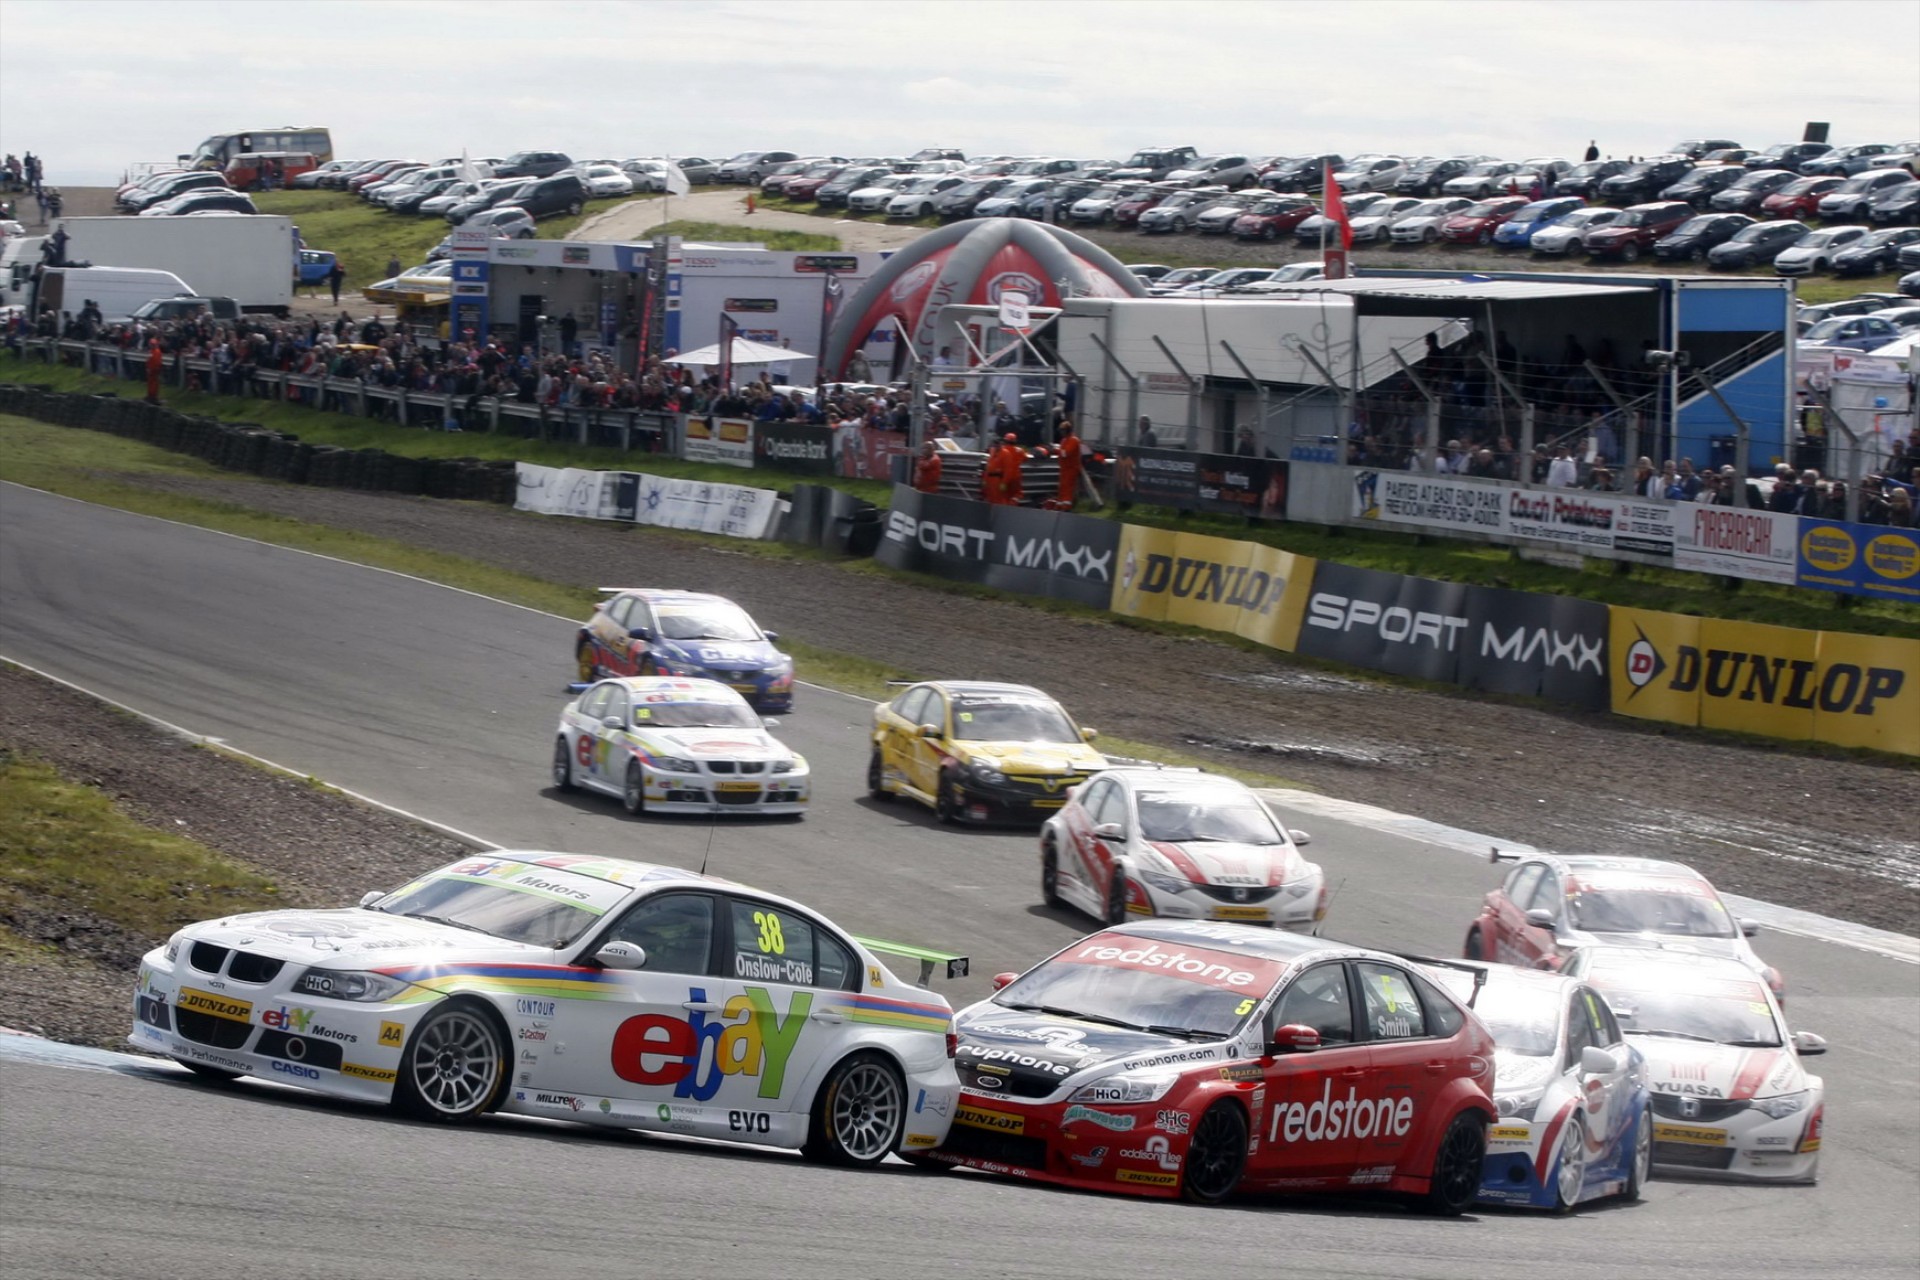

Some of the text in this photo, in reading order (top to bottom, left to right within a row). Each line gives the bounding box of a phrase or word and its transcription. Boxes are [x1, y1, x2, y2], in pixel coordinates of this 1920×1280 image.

[808, 440, 827, 459] Bank
[1386, 481, 1502, 510] PARTIES AT EAST END PARK
[1510, 492, 1549, 522] Couch
[1552, 496, 1613, 530] Potatoes
[1521, 523, 1537, 536] Home
[1695, 509, 1772, 557] FIREBREAK
[886, 510, 1112, 583] SPORT MAXX
[1138, 553, 1285, 615] DUNLOP
[1308, 592, 1603, 676] SPORT MAXX
[1670, 645, 1906, 716] DUNLOP
[516, 876, 591, 900] Motors
[1213, 876, 1262, 885] YUASA
[754, 911, 785, 955] 38
[736, 954, 812, 984] Onslow-Cole
[870, 969, 881, 983] AA
[1078, 945, 1256, 986] redstone
[307, 977, 333, 991] HiQ
[188, 995, 249, 1017] DUNLOP
[516, 999, 555, 1016] CONTOUR
[1233, 999, 1256, 1015] 5
[312, 1025, 358, 1043] Motors
[382, 1026, 401, 1042] AA
[524, 1029, 547, 1041] Castrol
[974, 1025, 1055, 1043] addison
[1378, 1015, 1411, 1037] Smith
[191, 1047, 254, 1072] Performance
[955, 1044, 1070, 1076] ruphone
[1124, 1048, 1215, 1071] truphone.com
[271, 1061, 320, 1080] CASIO
[343, 1065, 396, 1079] DUNLOP
[1096, 1089, 1121, 1100] HiQ
[1654, 1082, 1724, 1098] YUASA
[954, 1110, 1024, 1130] DUNLOP
[1062, 1104, 1136, 1131] Airwaves
[1156, 1110, 1190, 1128] SHC
[1269, 1077, 1414, 1143] redstone
[729, 1110, 771, 1134] evo
[1662, 1128, 1726, 1141] DUNLOP
[928, 1150, 1029, 1177] Breathe in. Move on.
[1120, 1149, 1160, 1161] addison
[1128, 1173, 1176, 1184] DUNLOP
